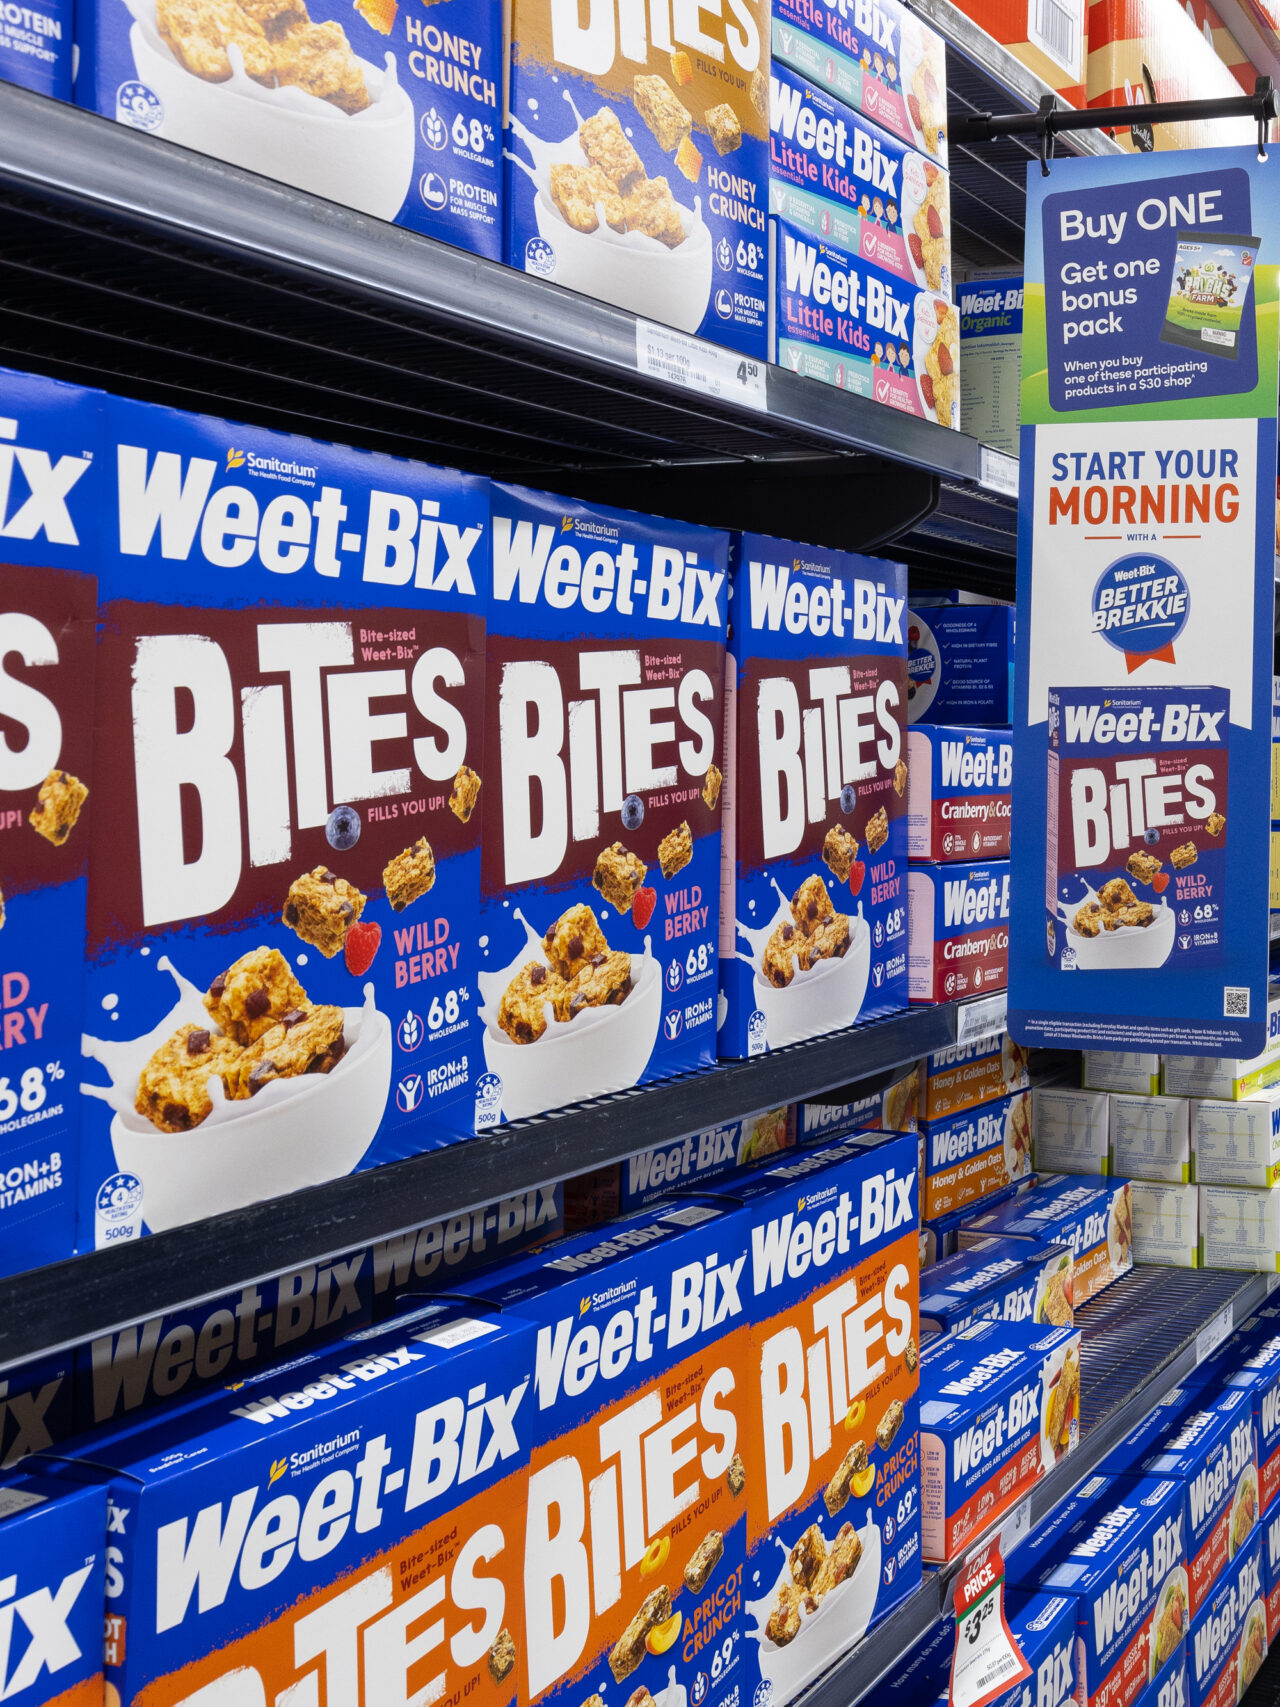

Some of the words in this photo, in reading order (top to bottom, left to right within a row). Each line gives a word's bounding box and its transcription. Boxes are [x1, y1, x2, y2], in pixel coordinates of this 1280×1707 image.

[406, 16, 482, 70] HONEY
[408, 50, 496, 107] CRUNCH
[696, 58, 717, 78] FILLS
[718, 66, 734, 86] YOU
[736, 74, 747, 93] UP!
[452, 113, 494, 152] 68%
[770, 76, 898, 199] Weet-Bix
[452, 146, 494, 168] WHOLEGRAINS
[770, 137, 818, 182] Little
[822, 163, 857, 202] Kids
[707, 165, 757, 204] HONEY
[771, 165, 805, 186] essentials
[449, 178, 497, 207] PROTEIN
[709, 192, 765, 232] CRUNCH
[1060, 209, 1127, 245] Buy
[1137, 190, 1223, 230] ONE
[736, 239, 764, 270] 68%
[1060, 260, 1108, 285] Get
[1113, 258, 1161, 280] one
[734, 292, 765, 312] PROTEIN
[785, 235, 910, 342] Weet-Bix
[961, 289, 1024, 315] Weet-Bi
[1062, 287, 1138, 312] bonus
[1191, 294, 1215, 303] FARM
[787, 297, 833, 336] Little
[837, 317, 870, 351] Kids
[787, 325, 820, 342] essentials
[961, 312, 1012, 333] Organic
[1063, 312, 1123, 344] pack
[1063, 361, 1098, 372] When
[1099, 358, 1120, 370] you
[1122, 355, 1143, 367] buy
[1064, 375, 1085, 385] one
[1087, 371, 1100, 382] of
[1100, 370, 1132, 381] these
[1134, 361, 1208, 379] participating
[1065, 384, 1114, 400] products
[1116, 382, 1127, 392] in
[1129, 382, 1137, 391] a
[1139, 378, 1162, 390] $30
[247, 452, 317, 478] Sanitarium
[1051, 451, 1145, 481] START
[1155, 449, 1239, 479] YOUR
[117, 443, 483, 596] Weet-Bix
[1049, 483, 1240, 525] MORNING
[1126, 533, 1149, 541] WITH
[1150, 533, 1157, 541] A
[492, 516, 726, 627] Weet-Bix
[1114, 564, 1156, 582] Weet-Bix
[749, 561, 906, 645] Weet-Bix
[1099, 575, 1179, 610] BETTER
[1092, 593, 1188, 633] BREKKIE
[360, 628, 416, 643] Bite-sized
[361, 646, 418, 661] Weet-Bix
[1112, 698, 1142, 707] Sanitarium
[1064, 704, 1226, 743] Weet-Bix
[941, 742, 1013, 787] Weet-B
[368, 806, 399, 823] FILLS
[401, 800, 426, 818] YOU
[428, 796, 445, 812] UP!
[870, 860, 896, 884] WILD
[1176, 874, 1207, 889] WILD
[664, 886, 702, 916] WILD
[871, 876, 901, 906] BERRY
[1176, 885, 1213, 900] BERRY
[664, 905, 709, 942] BERRY
[1193, 903, 1219, 920] 68%
[393, 917, 450, 957] WILD
[1193, 931, 1219, 942] IRON+B
[1193, 937, 1219, 948] VITAMINS
[395, 942, 460, 989] BERRY
[427, 986, 469, 1031] 68%
[428, 1020, 469, 1042] WHOLEGRAINS
[427, 1057, 468, 1084] IRON+B
[428, 1071, 469, 1099] VITAMINS
[932, 1113, 1004, 1167] Weet-Bix
[932, 1173, 956, 1189] Honey
[958, 1168, 964, 1178] &
[964, 1158, 987, 1176] Golden
[987, 1153, 1002, 1166] Oats
[105, 1224, 133, 1241] 500g
[752, 1168, 916, 1296] Weet-Bix
[592, 1277, 638, 1306] Sanitarium
[533, 1252, 746, 1411] Weet-Bix
[290, 1427, 363, 1469] Sanitarium
[953, 1384, 1041, 1483] Weet-Bix
[875, 1431, 919, 1489] APRICOT
[876, 1455, 918, 1507] CRUNCH
[156, 1375, 530, 1634] Weet-Bix
[967, 1548, 990, 1580] LOW
[963, 1562, 996, 1603] PRICE
[1093, 1511, 1183, 1656] Weet-Bix
[682, 1563, 744, 1643] APRICOT
[682, 1597, 742, 1664] CRUNCH
[711, 1629, 740, 1679] 69%
